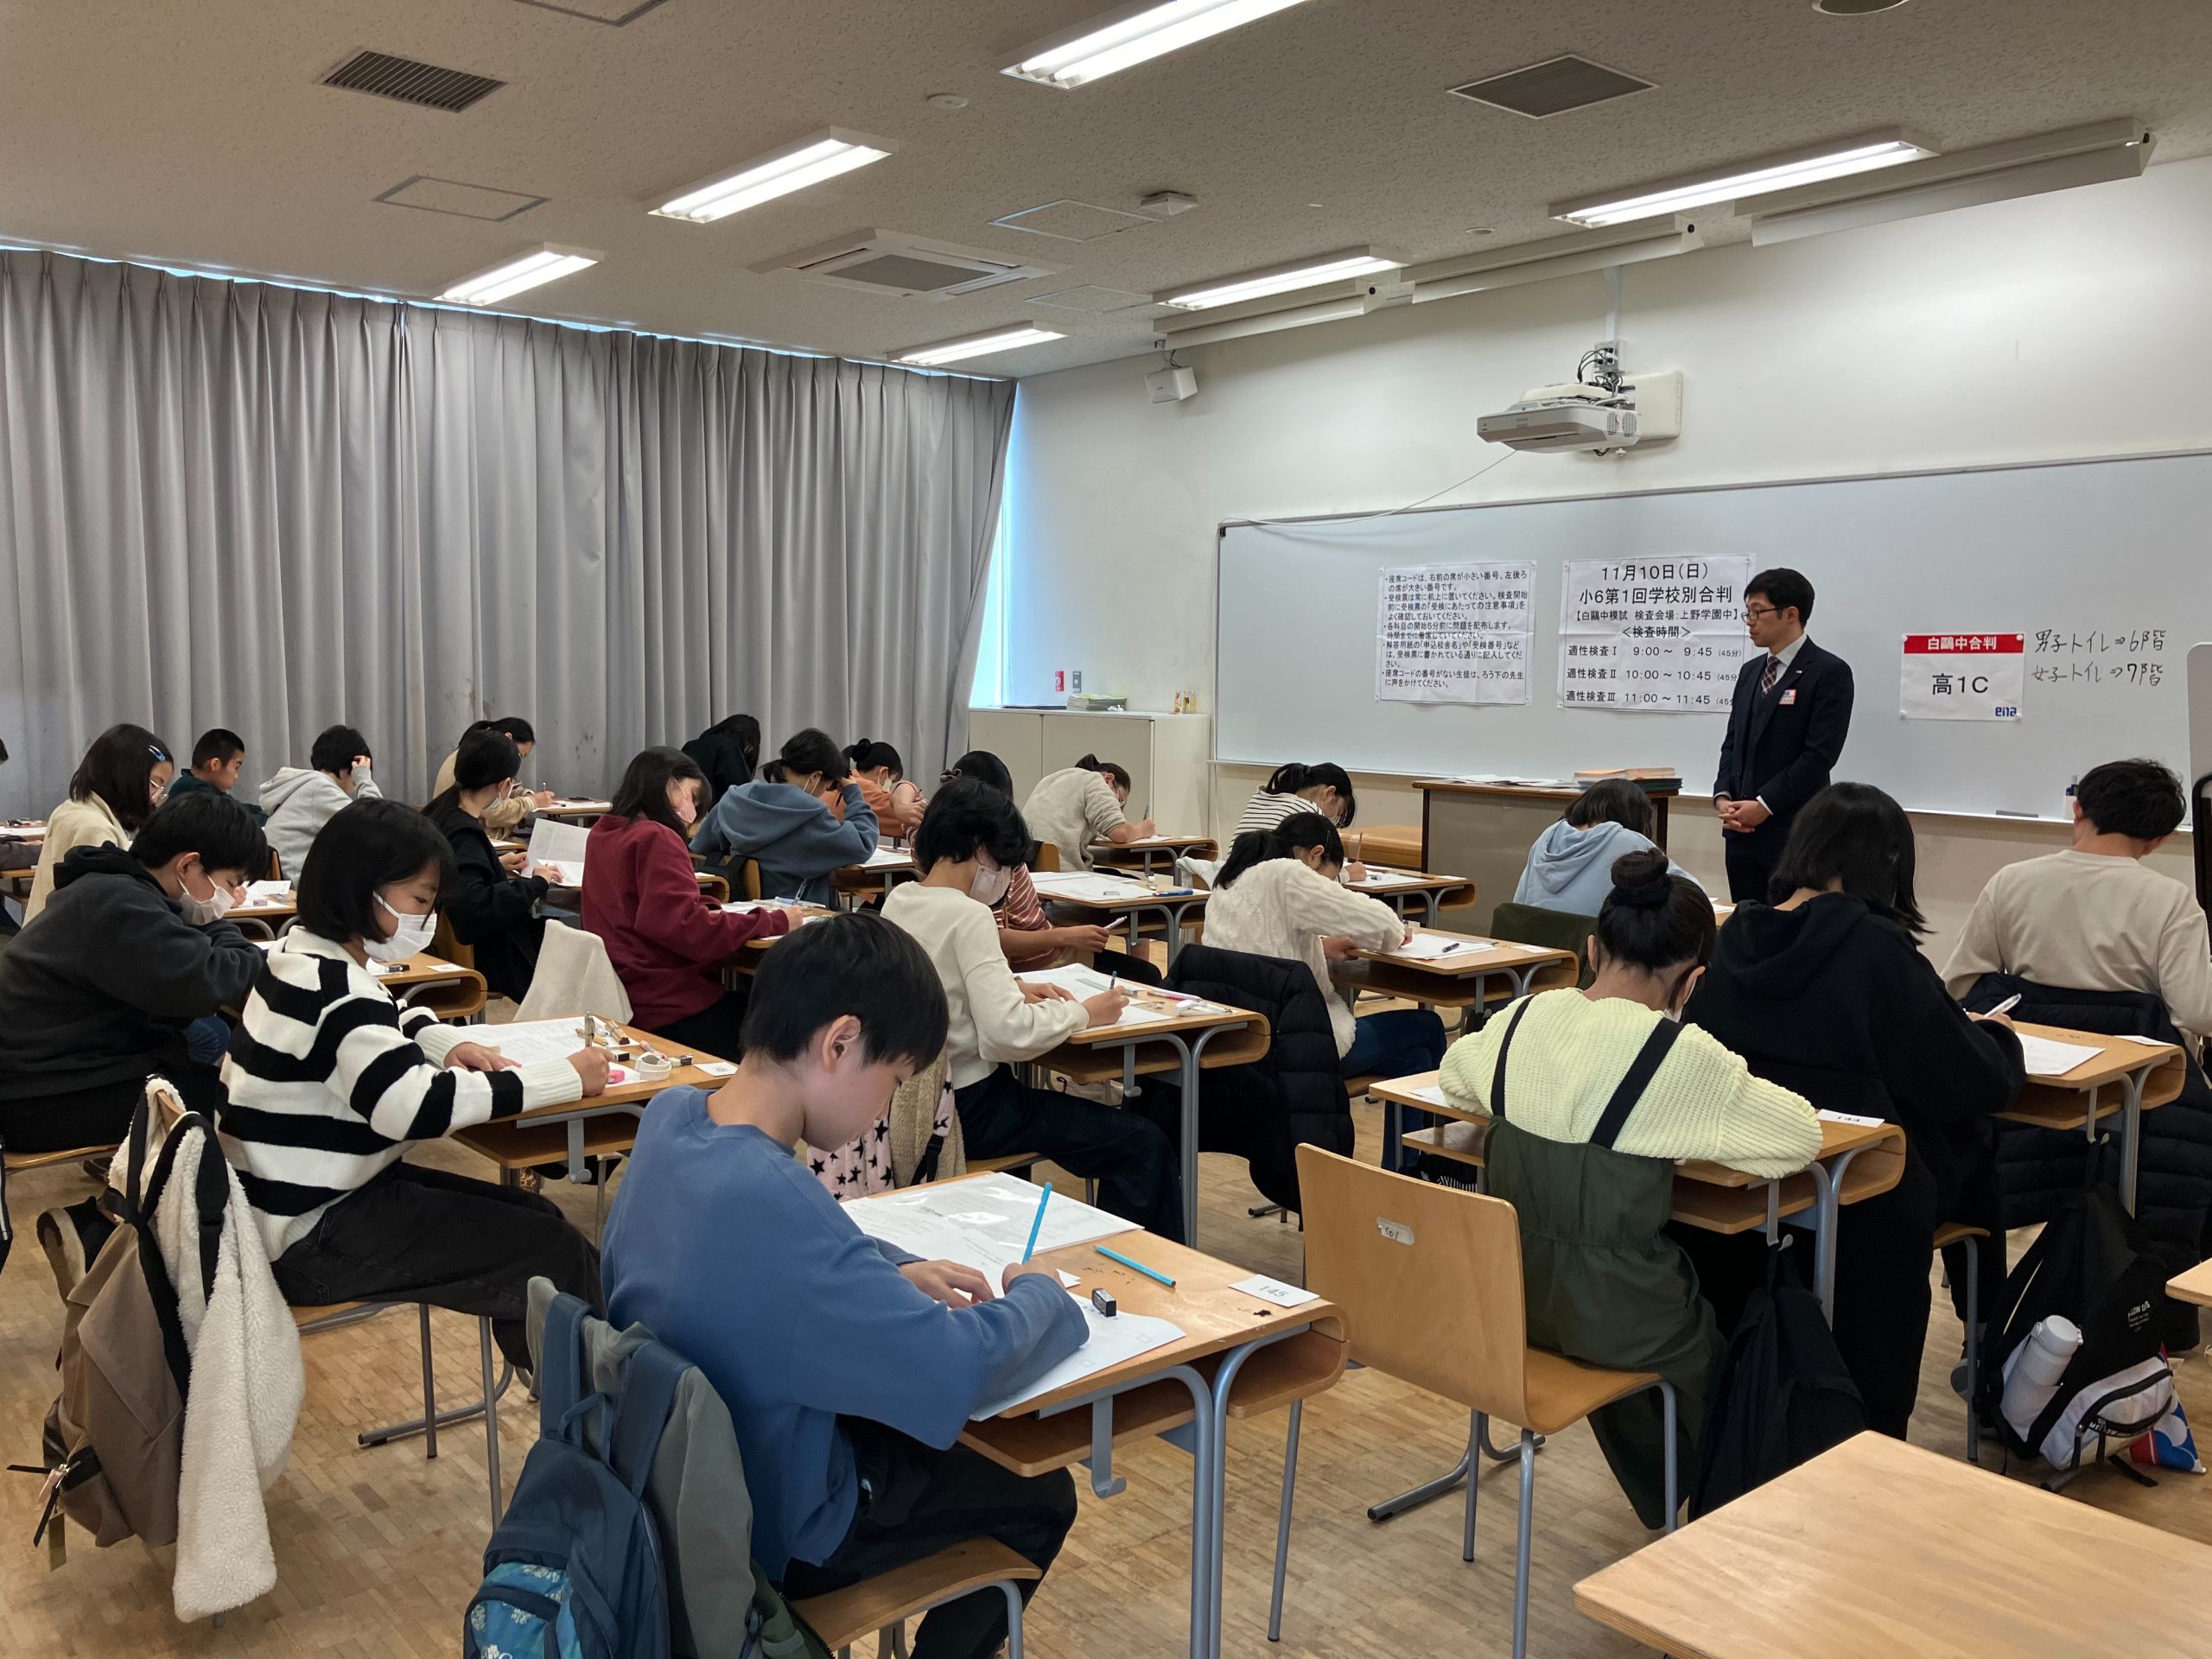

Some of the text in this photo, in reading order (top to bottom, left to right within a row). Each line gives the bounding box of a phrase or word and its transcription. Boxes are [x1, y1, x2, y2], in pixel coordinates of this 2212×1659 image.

[1601, 563, 1708, 582] 11月10日(日)
[1580, 586, 1732, 605] 小6第1回学校別合判
[2035, 629, 2166, 652] 男子トイレ 6階
[2031, 661, 2163, 686] 女子トイレ 7階
[1932, 673, 1989, 695] 高1C
[1995, 707, 2017, 716] ena
[1259, 1285, 1289, 1298] 145
